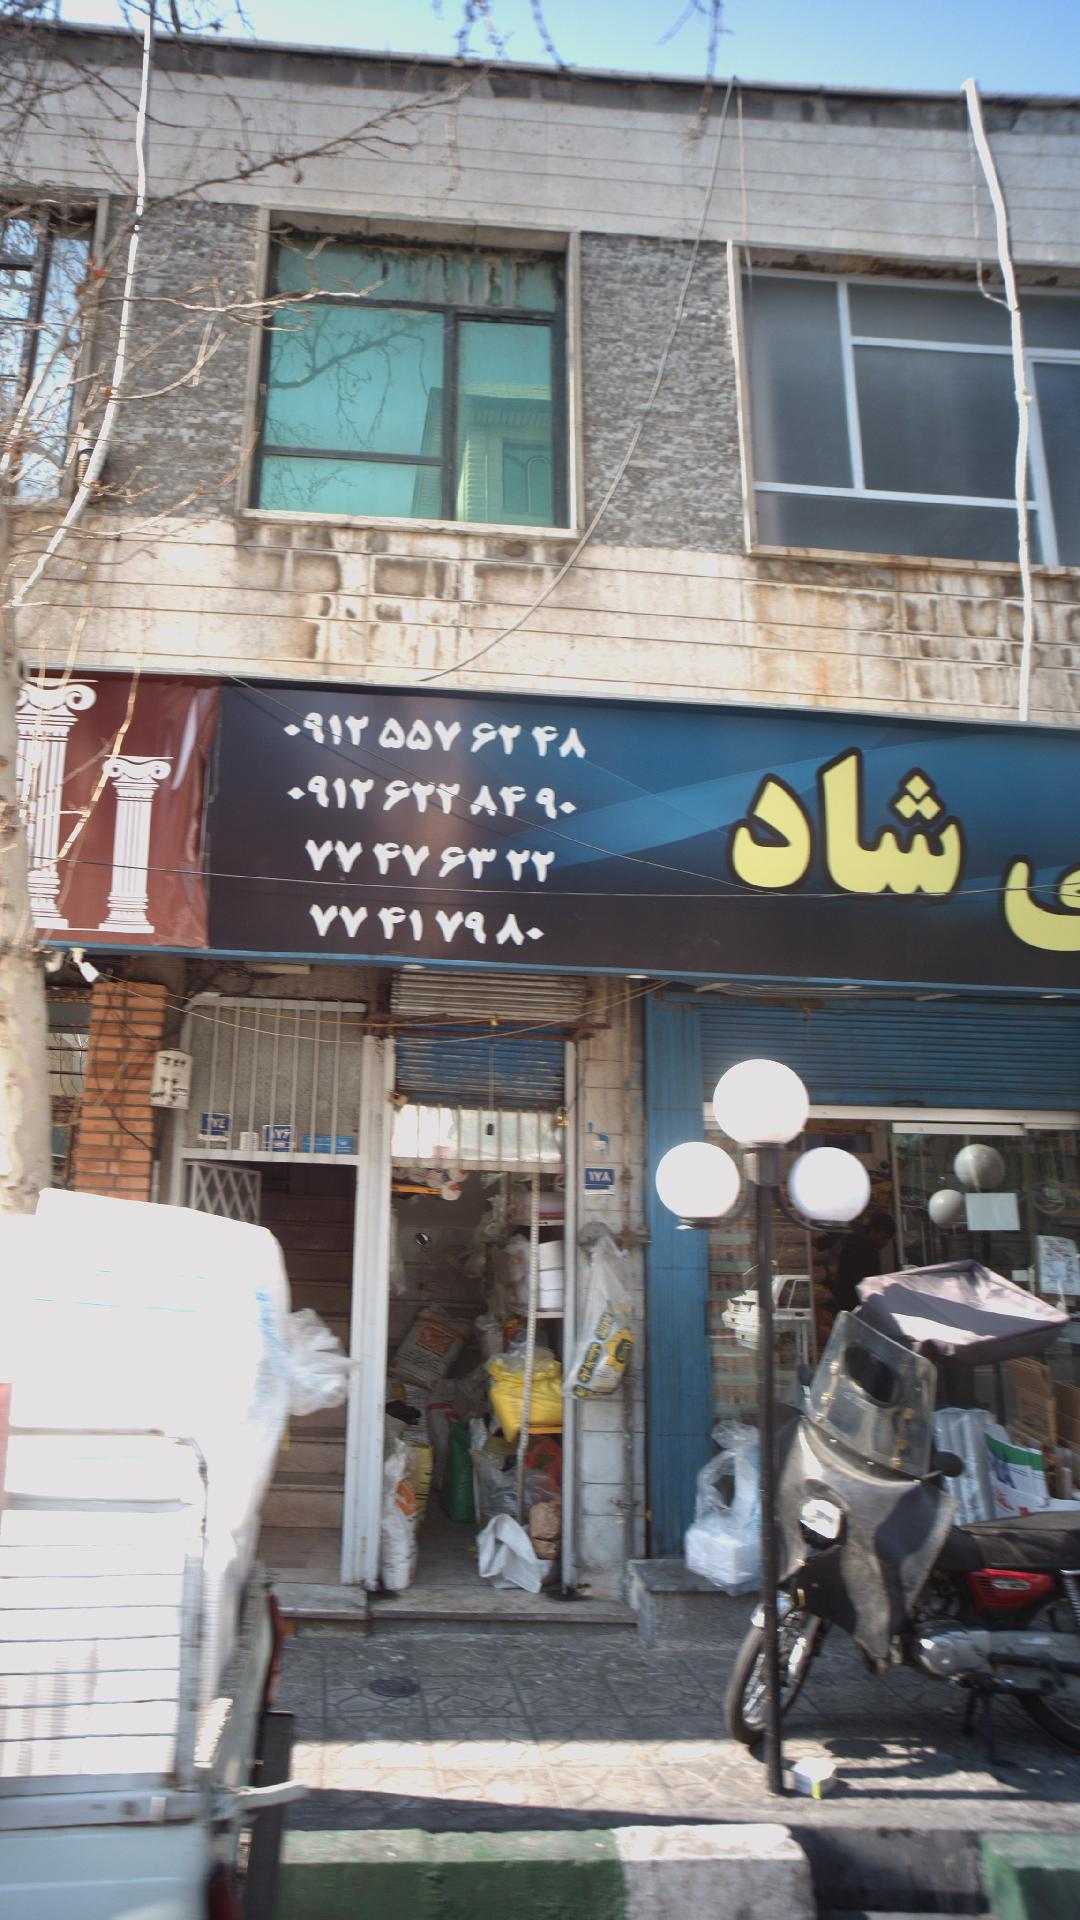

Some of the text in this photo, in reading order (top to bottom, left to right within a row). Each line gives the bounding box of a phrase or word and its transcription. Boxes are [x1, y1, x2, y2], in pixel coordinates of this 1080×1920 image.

[283, 711, 586, 758] ۰۹۱۲ ۵۵۷ ۶۲ ۴۸
[287, 775, 577, 820] ۰۹۱۲ ۶۲۲ ۸۴ ۹۰
[730, 751, 963, 897] شاد
[305, 839, 555, 883] ۷۷ ۴۷ ۶۳ ۲۲
[309, 904, 545, 946] ۷۷ ۴۱ ۷۹ ۸۰
